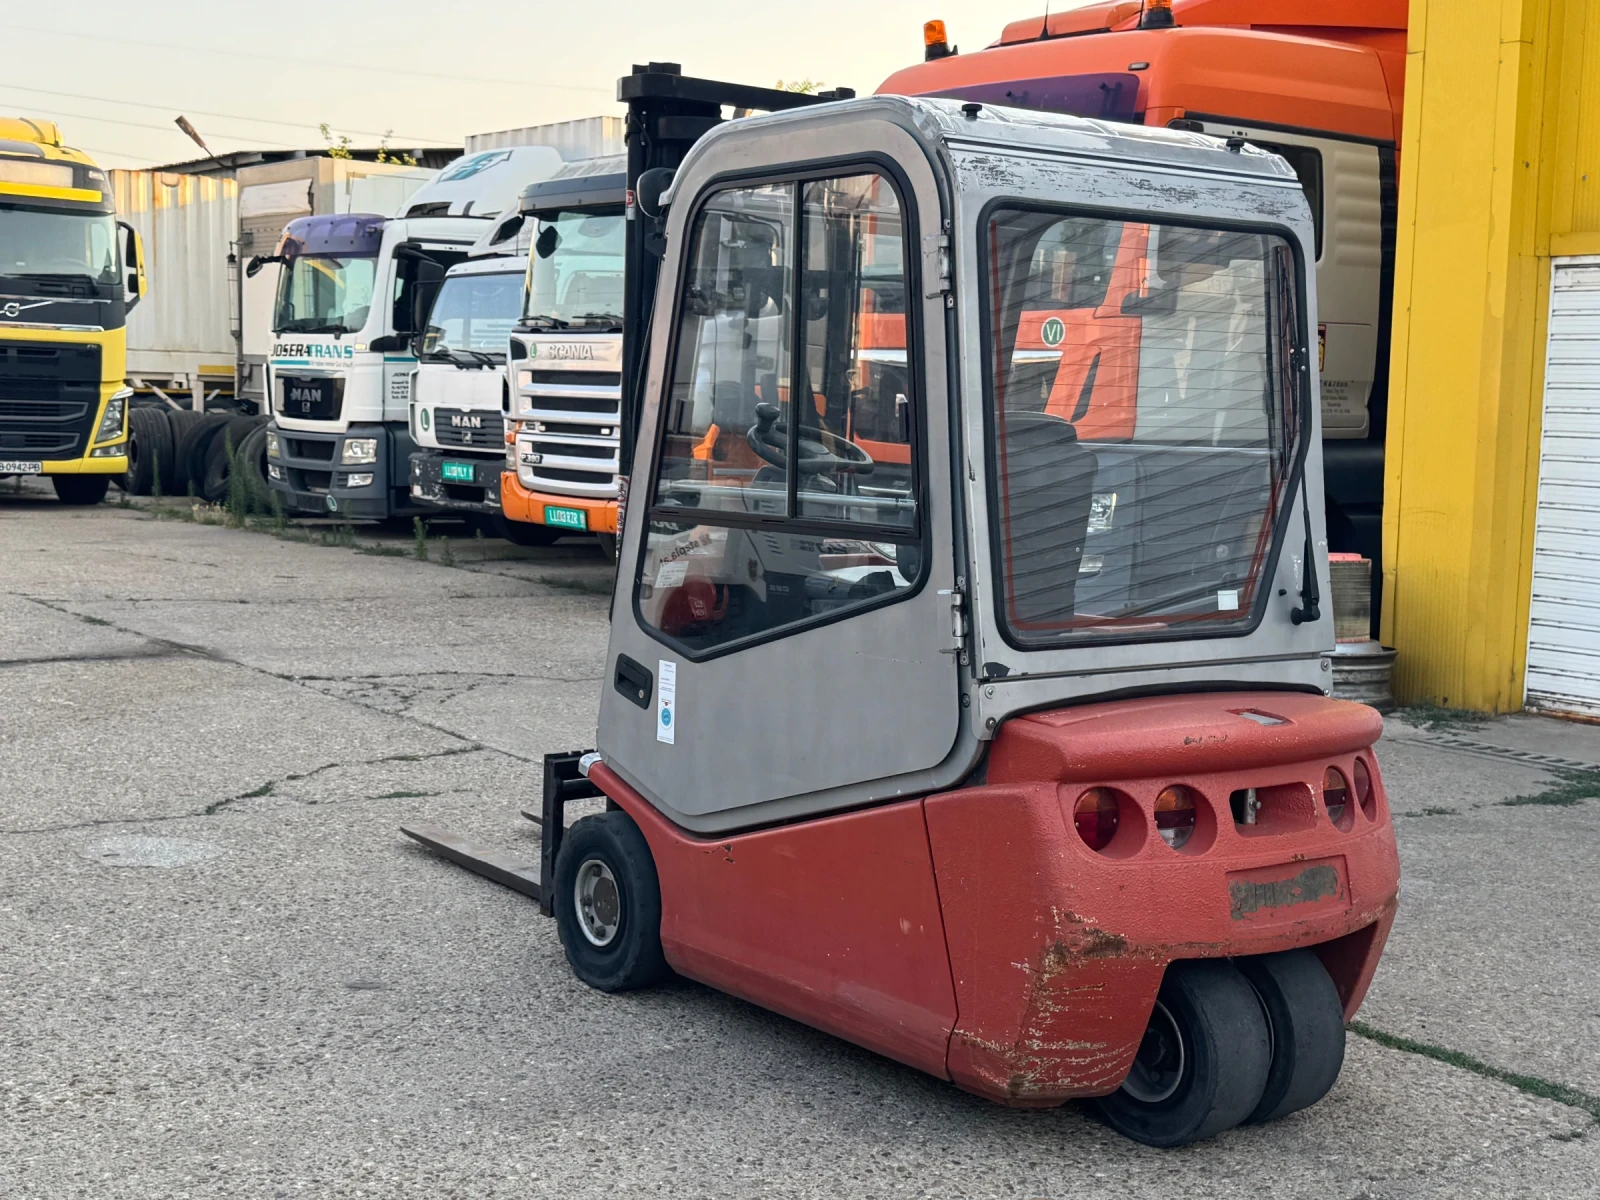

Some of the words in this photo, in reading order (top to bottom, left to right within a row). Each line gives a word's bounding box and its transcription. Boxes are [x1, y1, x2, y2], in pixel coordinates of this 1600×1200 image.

[549, 344, 594, 360] SCANIA
[290, 387, 322, 402] MAN
[451, 415, 481, 428] MAN
